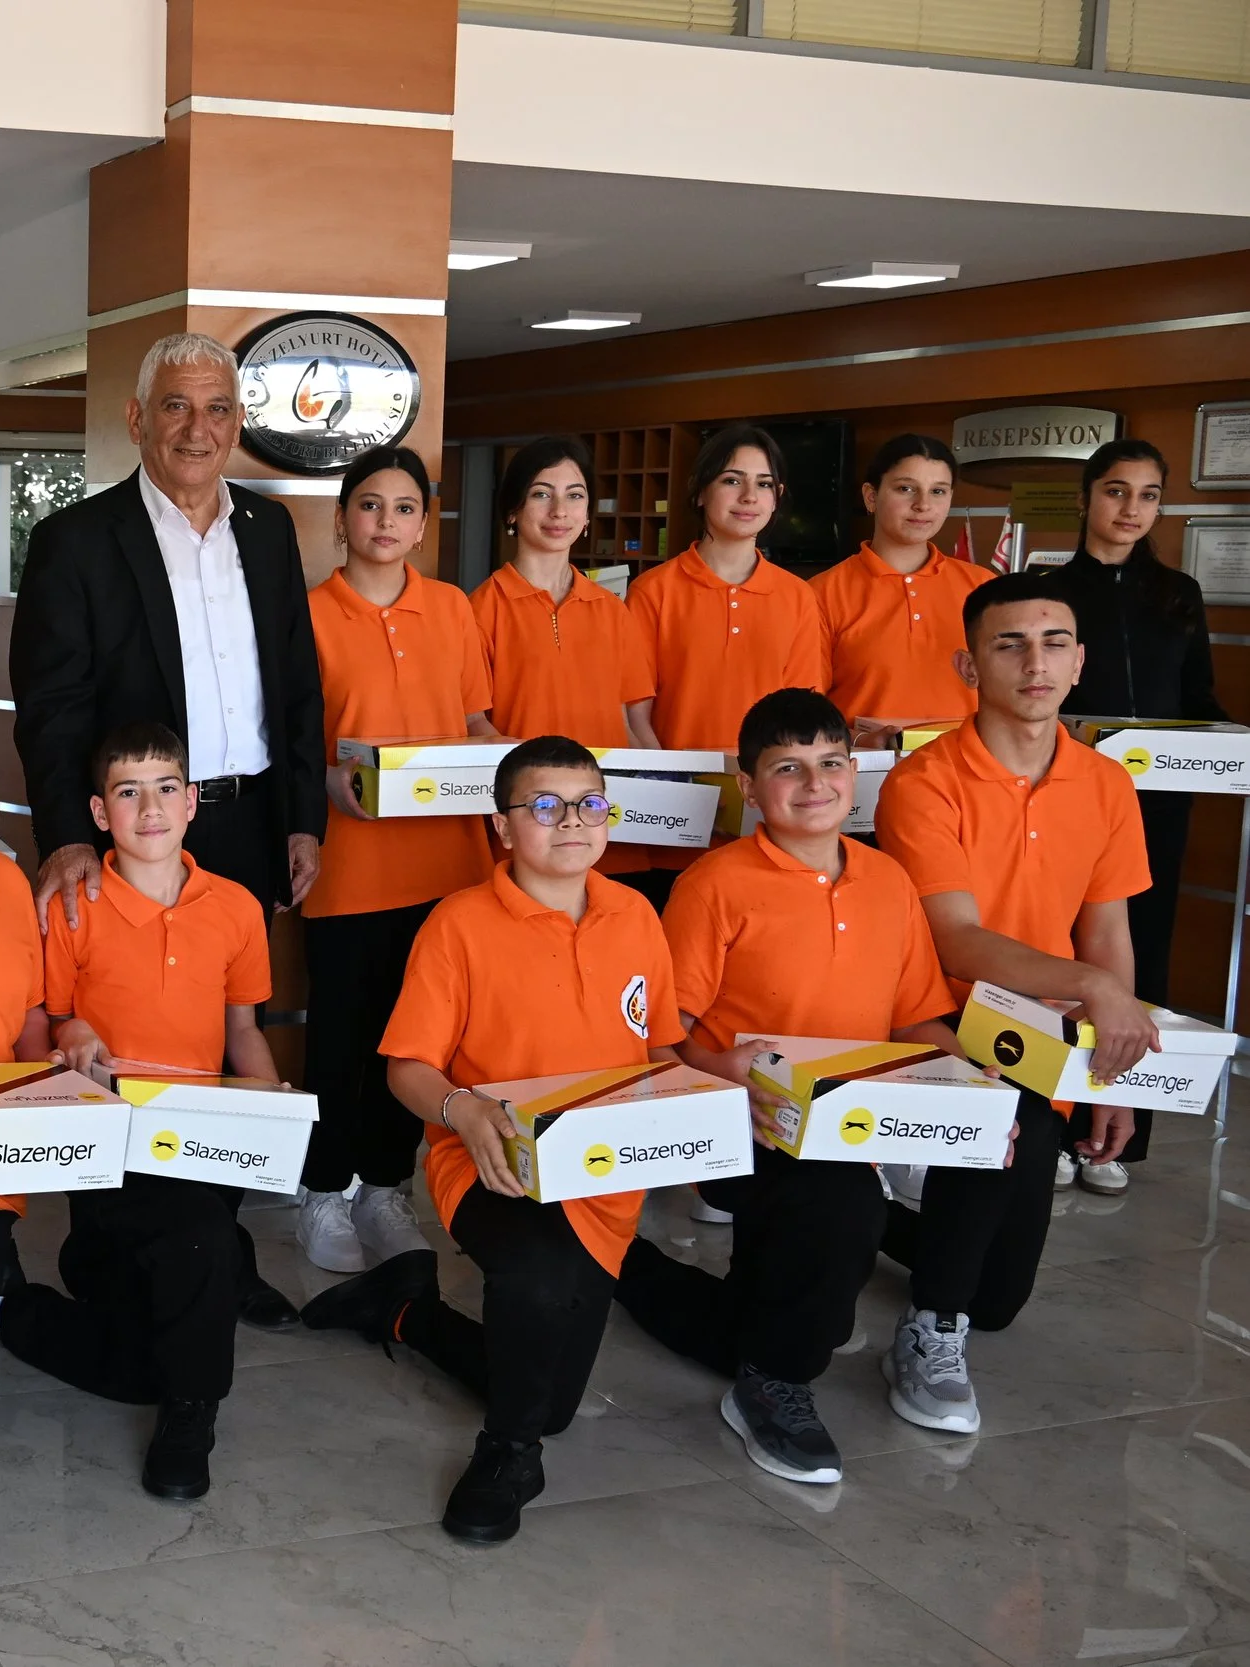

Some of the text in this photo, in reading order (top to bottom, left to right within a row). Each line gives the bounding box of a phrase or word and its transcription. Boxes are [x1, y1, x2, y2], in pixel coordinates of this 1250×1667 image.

[963, 422, 1104, 448] RESEPSİYON
[1155, 755, 1245, 775] Slazenger
[623, 808, 689, 829] Slazenger
[877, 1116, 982, 1145] Slazenger
[182, 1140, 270, 1168] Slazenger
[618, 1136, 714, 1164] Slazenger
